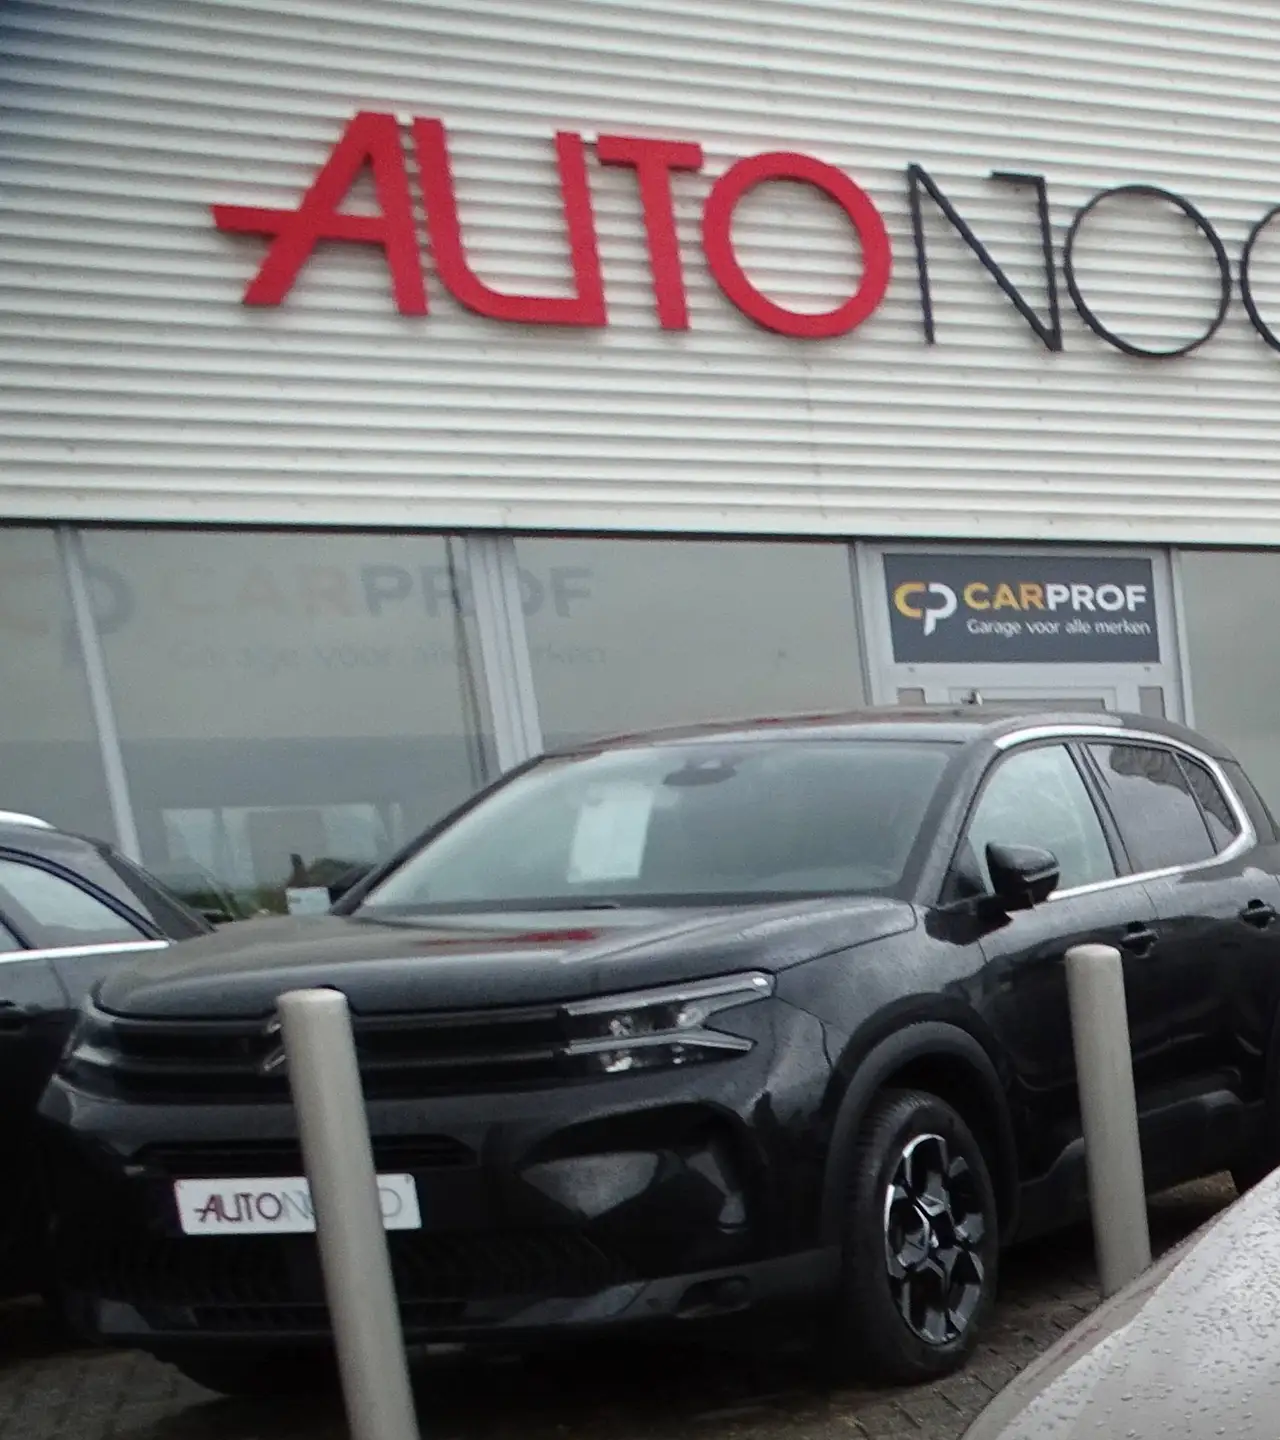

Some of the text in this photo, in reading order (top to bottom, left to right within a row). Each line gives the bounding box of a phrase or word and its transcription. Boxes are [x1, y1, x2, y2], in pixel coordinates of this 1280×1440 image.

[963, 582, 1147, 612] CARPROF
[967, 617, 1151, 638] Garage voor alle merken
[194, 1185, 403, 1222] AUTOND
